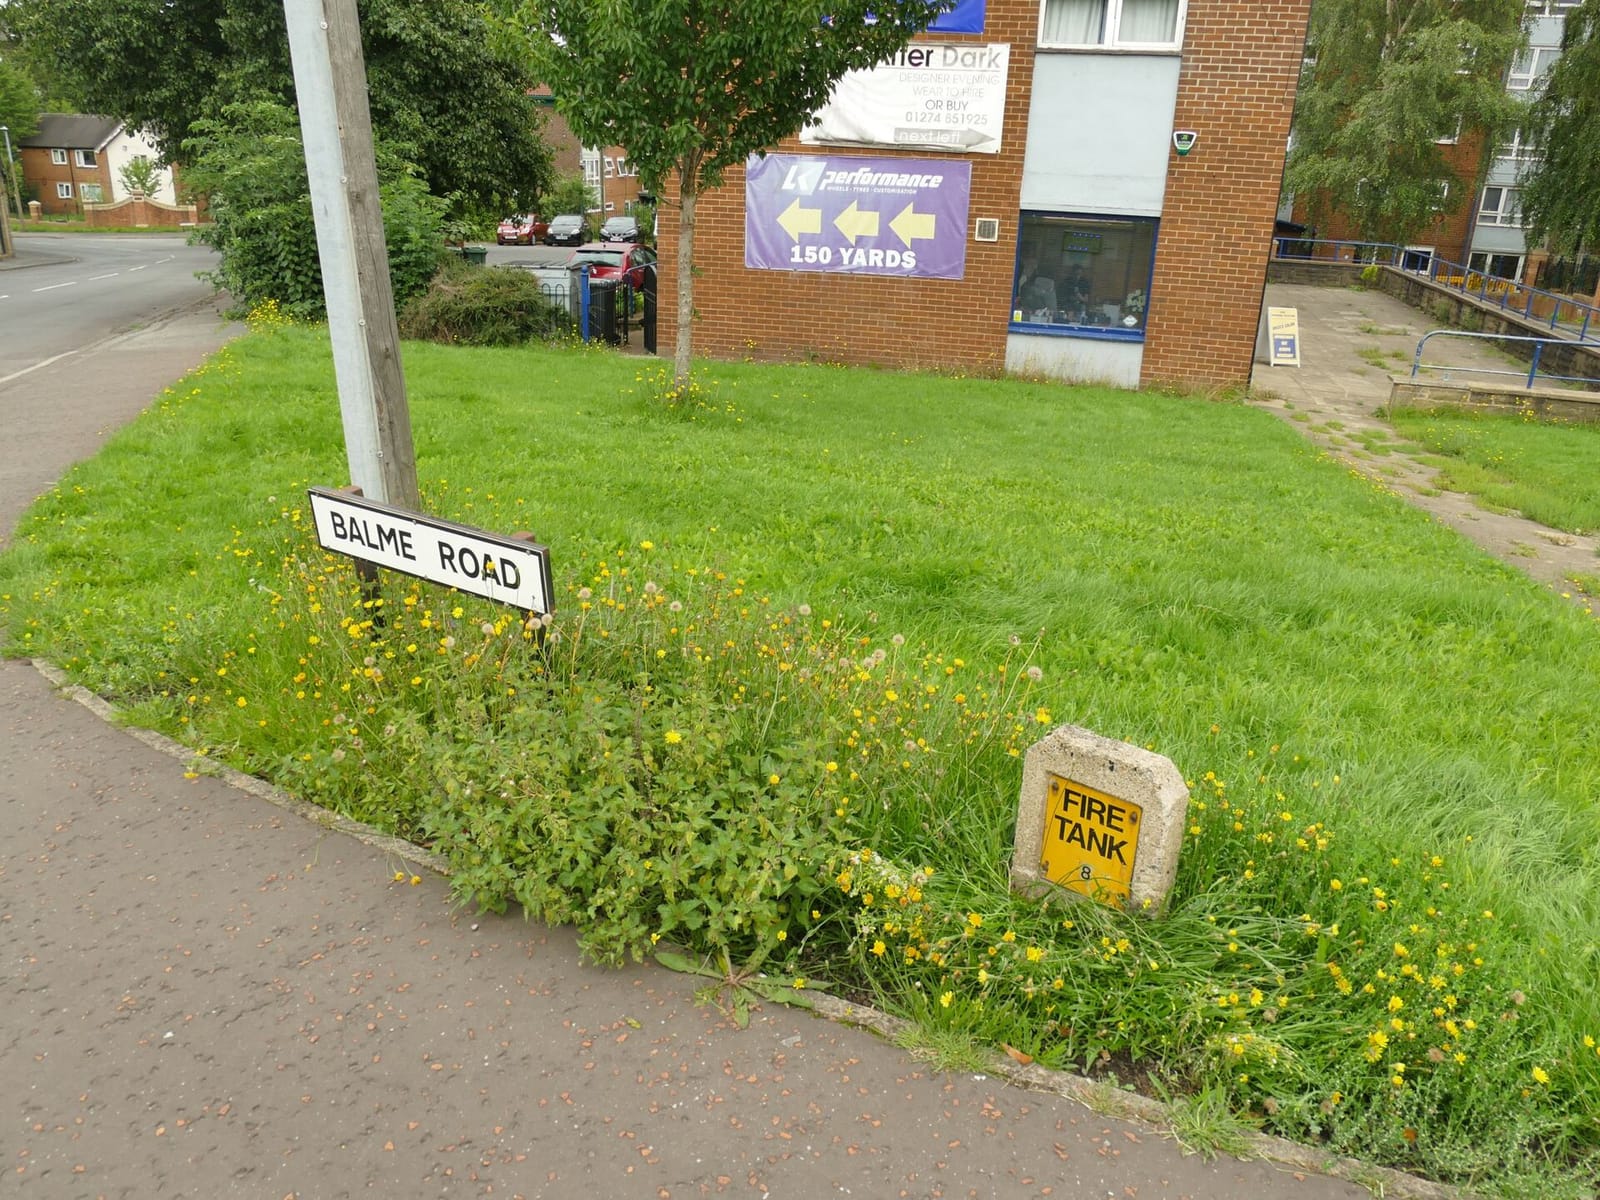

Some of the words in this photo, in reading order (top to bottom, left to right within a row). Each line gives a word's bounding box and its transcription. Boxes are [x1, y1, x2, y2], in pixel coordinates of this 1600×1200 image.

[942, 46, 1001, 69] Dark
[900, 72, 951, 84] DESIGNER
[953, 74, 1000, 86] EVENING
[913, 86, 944, 97] WEAR
[947, 87, 960, 97] TO
[963, 88, 985, 98] HIRE
[925, 99, 944, 110] OR
[946, 100, 969, 111] BUY
[905, 111, 941, 123] 01274
[945, 113, 988, 126] 651925
[899, 131, 933, 142] next
[937, 131, 960, 144] left
[818, 167, 944, 191] performance
[790, 245, 832, 264] 150
[838, 247, 917, 269] YARDS
[330, 511, 416, 561] BALME
[437, 540, 521, 590] ROAD
[1063, 788, 1126, 833] FIRE
[1054, 814, 1128, 866] TANK
[1080, 866, 1091, 881] 8
